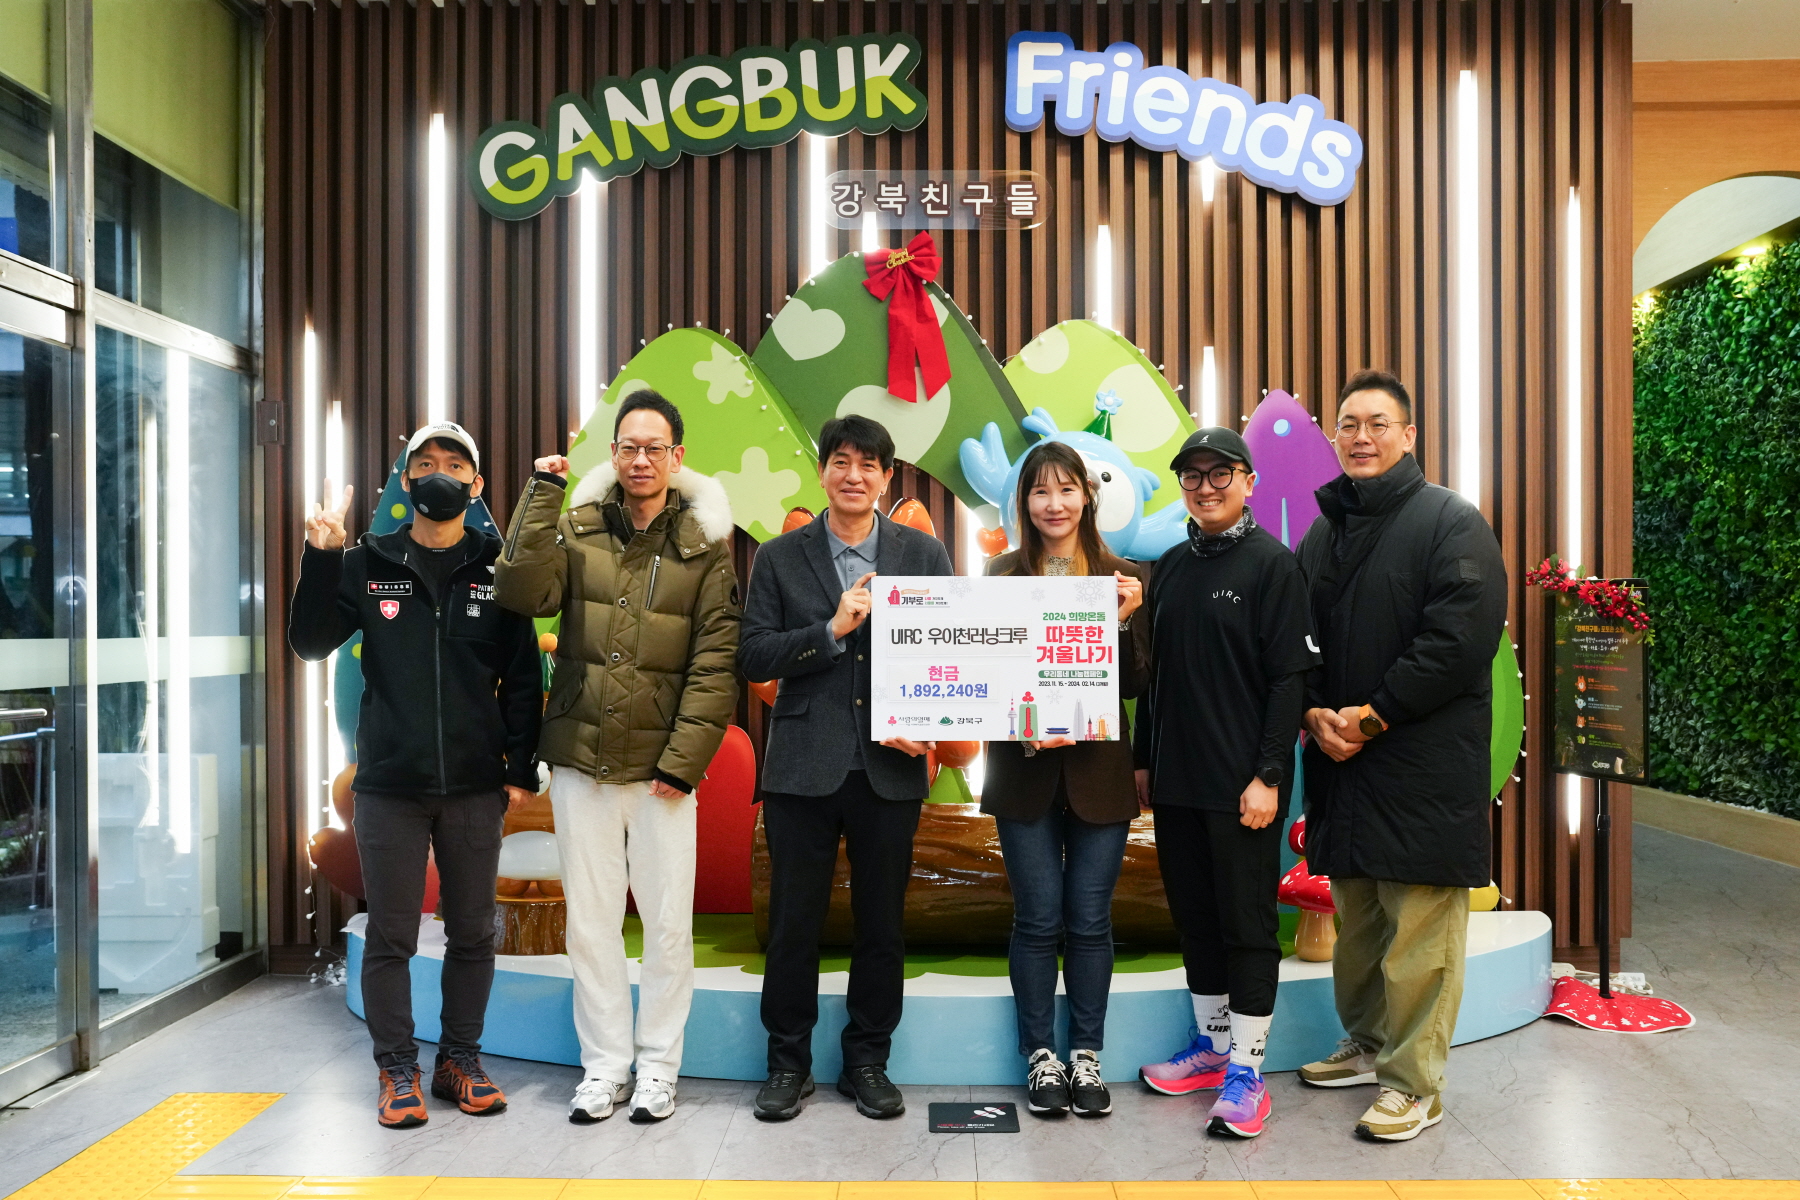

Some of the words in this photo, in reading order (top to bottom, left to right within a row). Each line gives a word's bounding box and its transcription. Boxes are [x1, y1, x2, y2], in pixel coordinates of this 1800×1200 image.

[478, 42, 918, 206] GANGBUK
[1015, 41, 1355, 191] Friends
[829, 179, 1040, 219] 강북친구들
[901, 596, 924, 606] 기부로
[1212, 589, 1242, 604] UIRC
[1042, 612, 1067, 621] 2024
[1068, 611, 1106, 622] 희망온돌
[891, 628, 922, 645] UIRC
[927, 627, 1028, 646] 우이천러닝크루
[1045, 625, 1104, 644] 따뜻한
[1036, 645, 1113, 664] 겨울나기
[928, 665, 960, 682] 현금
[899, 683, 988, 699] 1,892,240원
[956, 717, 983, 725] 강북구
